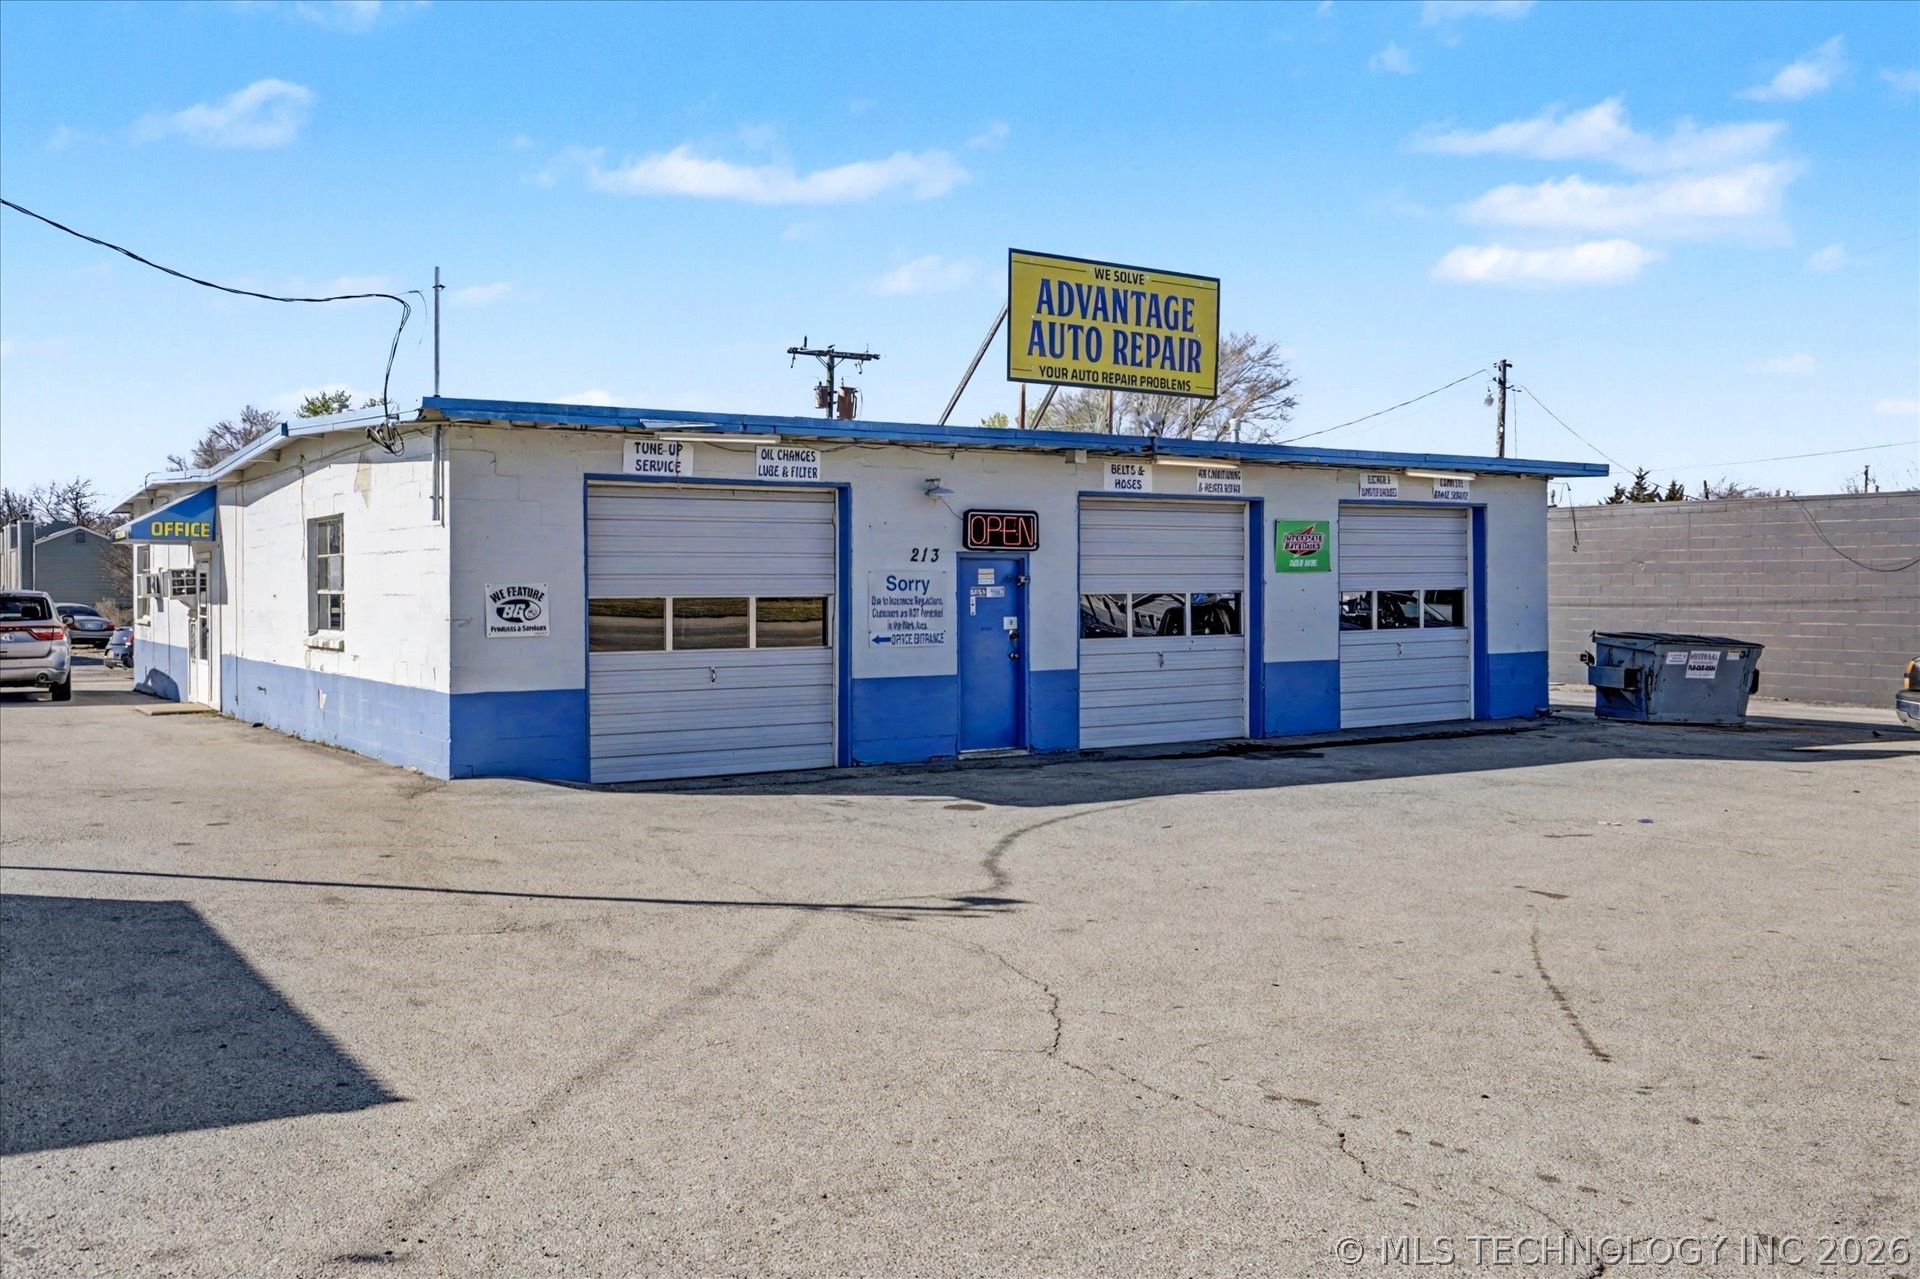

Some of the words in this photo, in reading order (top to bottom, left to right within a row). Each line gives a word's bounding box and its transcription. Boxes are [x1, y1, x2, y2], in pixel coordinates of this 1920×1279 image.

[1094, 267, 1111, 281] WE
[1114, 270, 1145, 285] SOLVE
[1036, 278, 1195, 333] ADVANTAGE
[1027, 320, 1103, 363] AUTO
[1112, 329, 1202, 374] REPAIR
[1039, 365, 1069, 379] YOUR
[1071, 370, 1099, 383] AUTO
[1101, 372, 1137, 387] REPAIR
[1140, 376, 1191, 392] PROBLEMS
[634, 442, 683, 457] TUNE-UP
[761, 448, 774, 461] OIL
[777, 449, 816, 463] CHANGES
[635, 459, 681, 474] SERVICE
[758, 465, 779, 477] LUBE
[782, 465, 788, 478] &
[791, 466, 818, 479] FILTER
[1111, 464, 1136, 476] BELTS
[1138, 465, 1145, 476] &
[1115, 479, 1142, 490] HOSES
[151, 522, 211, 537] OFFICE
[970, 515, 1034, 546] OPEN
[910, 547, 940, 562] 213
[886, 575, 930, 595] Sorry
[489, 589, 506, 603] WE
[506, 586, 545, 602] FEATURE
